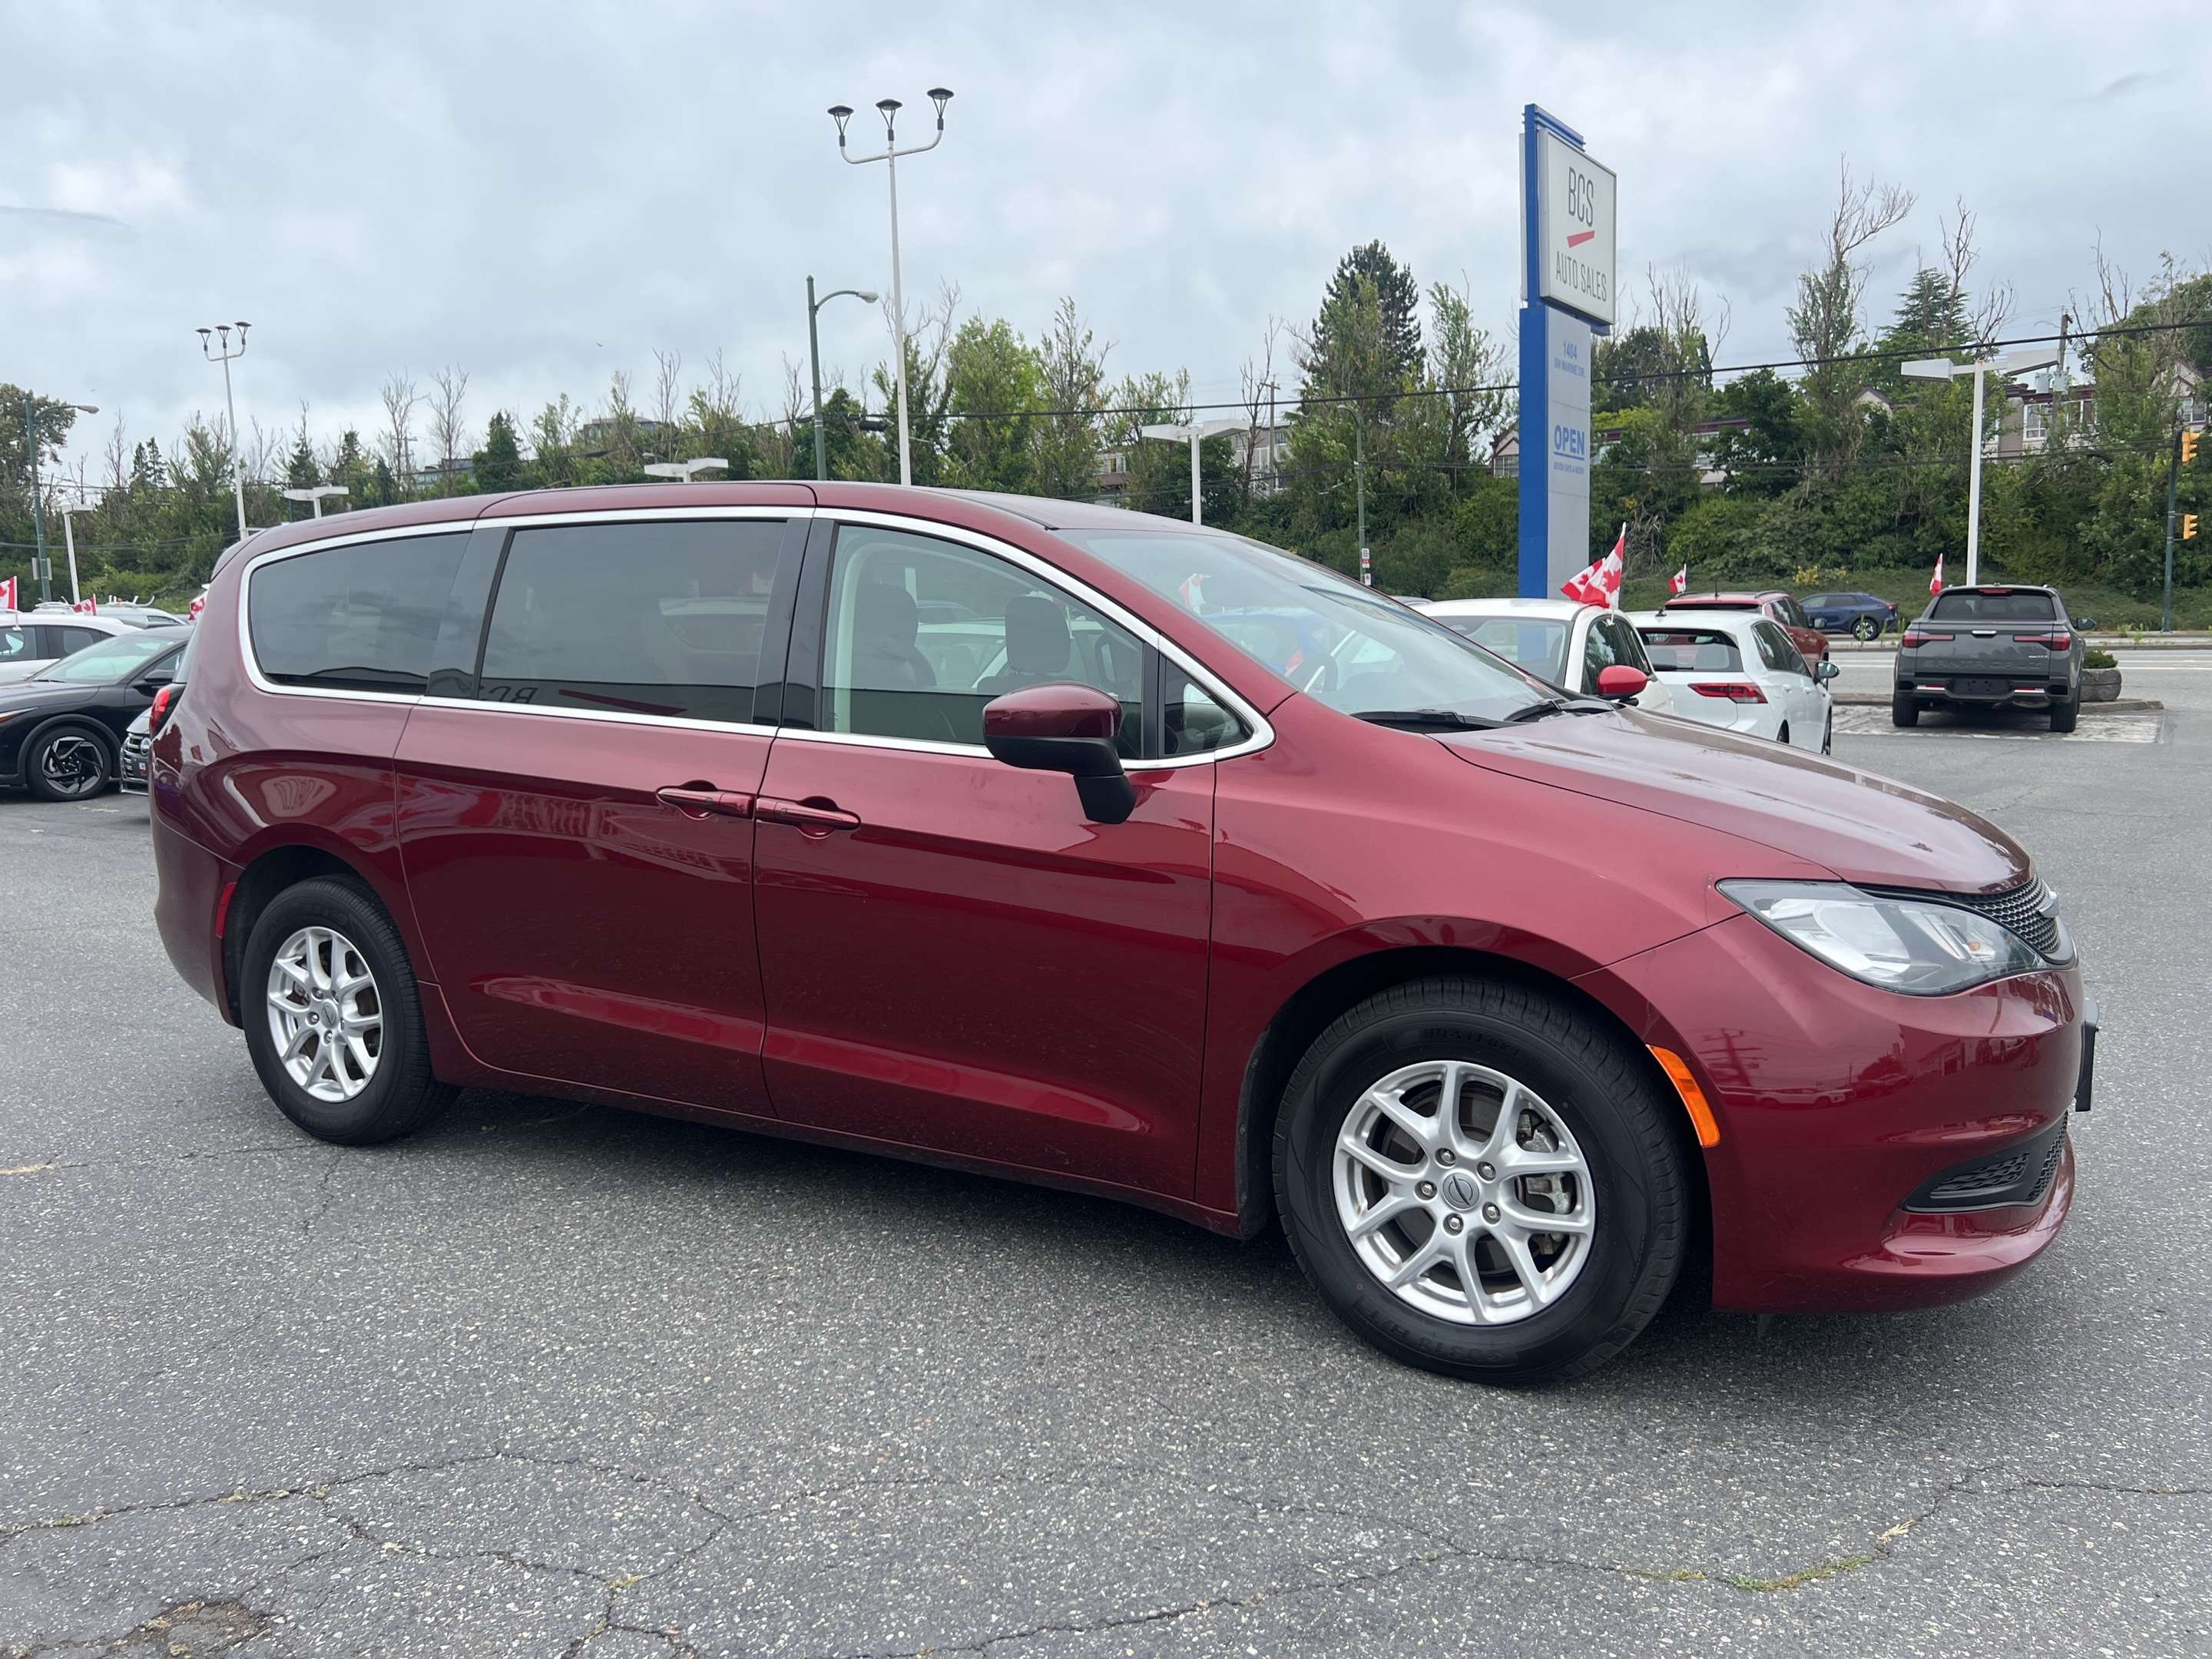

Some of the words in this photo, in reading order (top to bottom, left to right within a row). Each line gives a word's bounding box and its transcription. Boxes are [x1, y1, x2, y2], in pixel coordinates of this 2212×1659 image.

[1568, 167, 1594, 227] BCS
[1556, 251, 1578, 290] AUTO
[1581, 263, 1607, 302] SALES
[1564, 341, 1577, 360] 1404
[1554, 425, 1584, 455] OPEN
